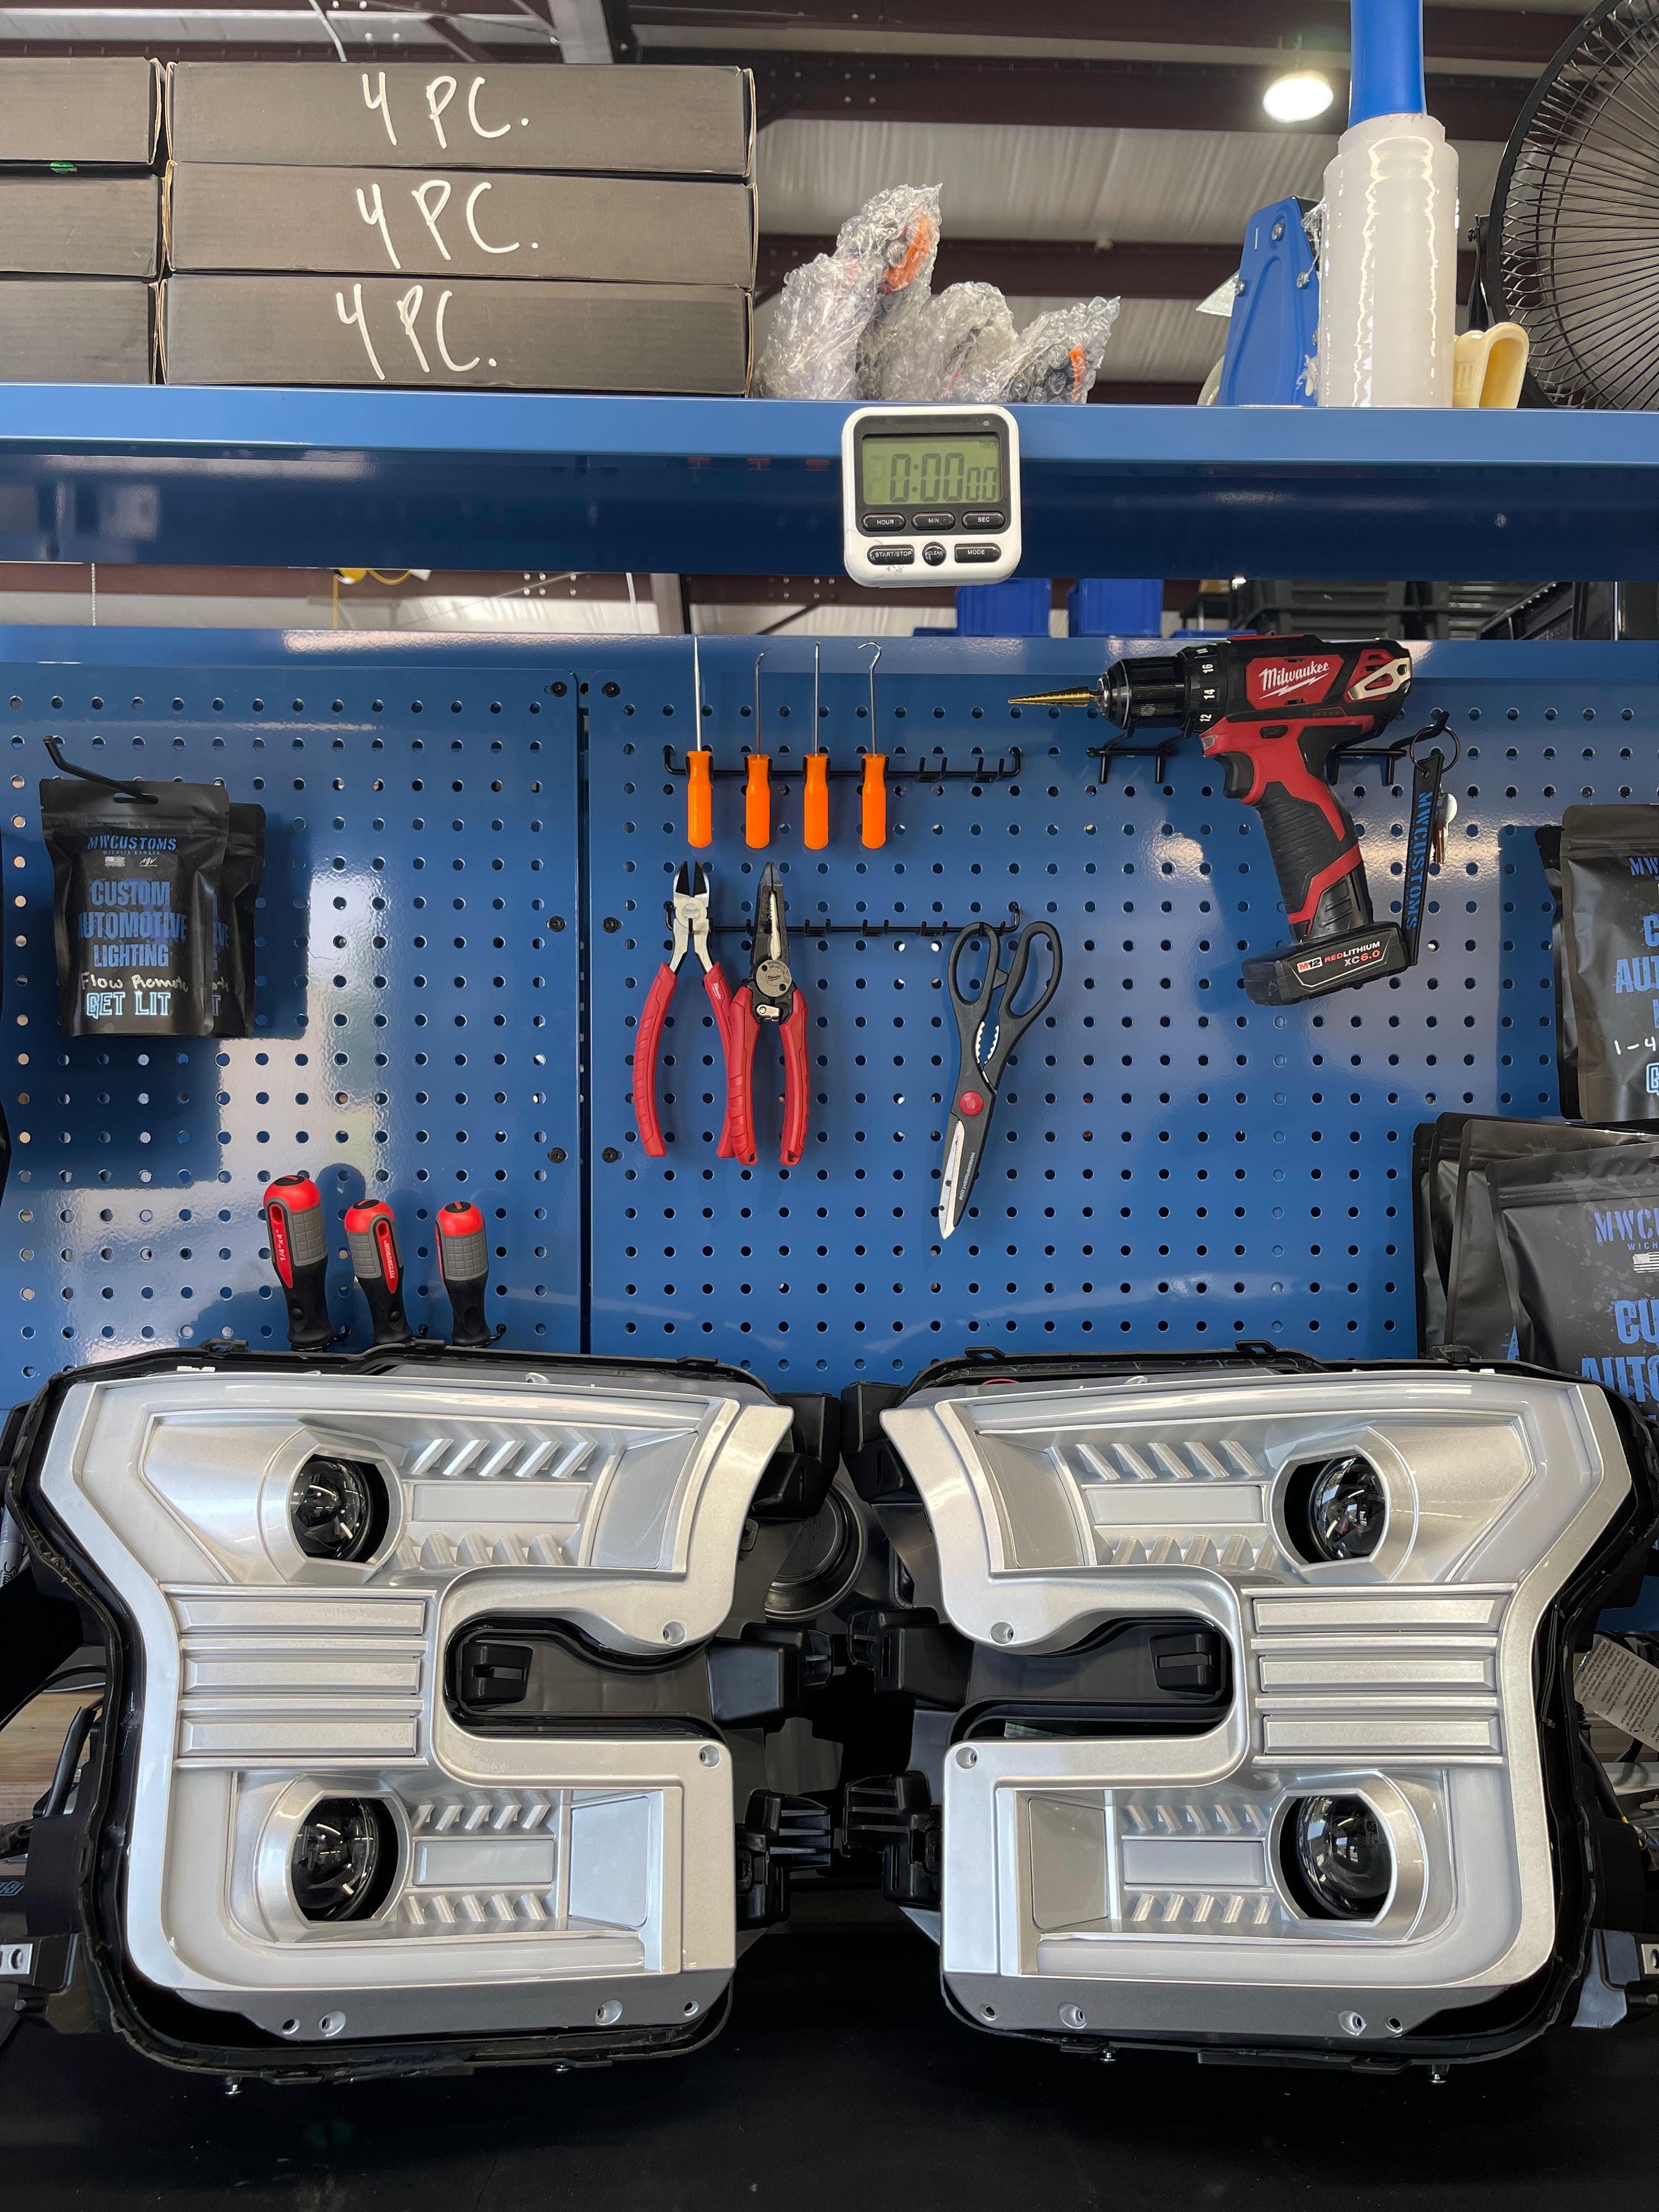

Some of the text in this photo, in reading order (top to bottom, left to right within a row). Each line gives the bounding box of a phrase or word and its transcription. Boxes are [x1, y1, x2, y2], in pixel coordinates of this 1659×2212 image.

[362, 71, 529, 149] 4 PC.
[356, 179, 539, 269] 4 PC.
[335, 283, 498, 380] 4 PC.
[1202, 664, 1214, 674] 16
[1258, 661, 1330, 692] Milwaukee
[1203, 689, 1216, 700] 14
[1199, 714, 1212, 722] 12
[87, 834, 177, 851] MWCUSTOMS
[1406, 791, 1434, 930] MWCUSTOMS
[91, 881, 170, 906] CUSTOM
[94, 944, 169, 967] LIGHTING
[1298, 941, 1381, 970] M12 REDLITHIUM
[1344, 950, 1381, 967] XC6.0
[81, 971, 123, 990] Flow
[86, 990, 171, 1019] GET LIT
